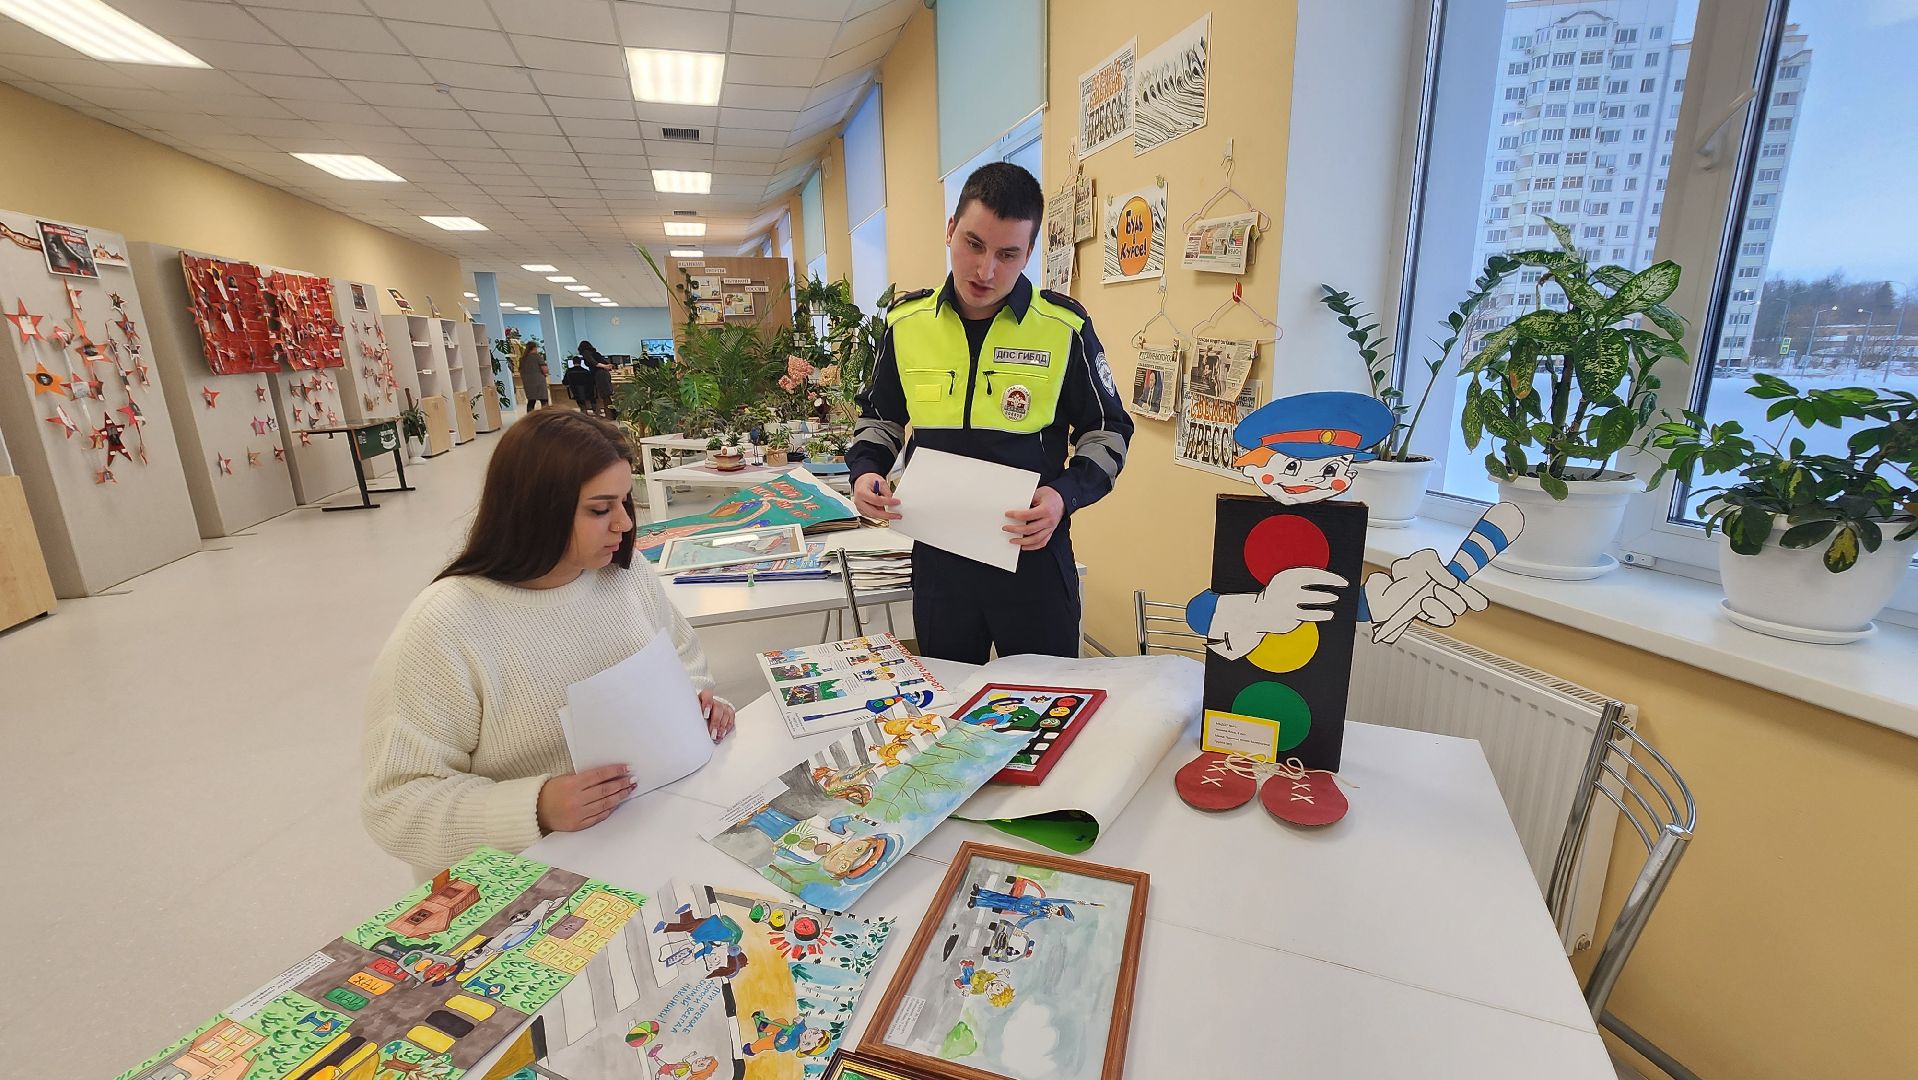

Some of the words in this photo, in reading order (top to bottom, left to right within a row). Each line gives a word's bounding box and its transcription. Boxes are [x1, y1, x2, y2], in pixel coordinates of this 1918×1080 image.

[996, 350, 1016, 360] ДПС
[1017, 351, 1048, 364] ГИБДД
[922, 671, 947, 692] ДОРОГУ
[707, 986, 721, 1001] ПРИ
[670, 1006, 695, 1033] ВСЕГДА
